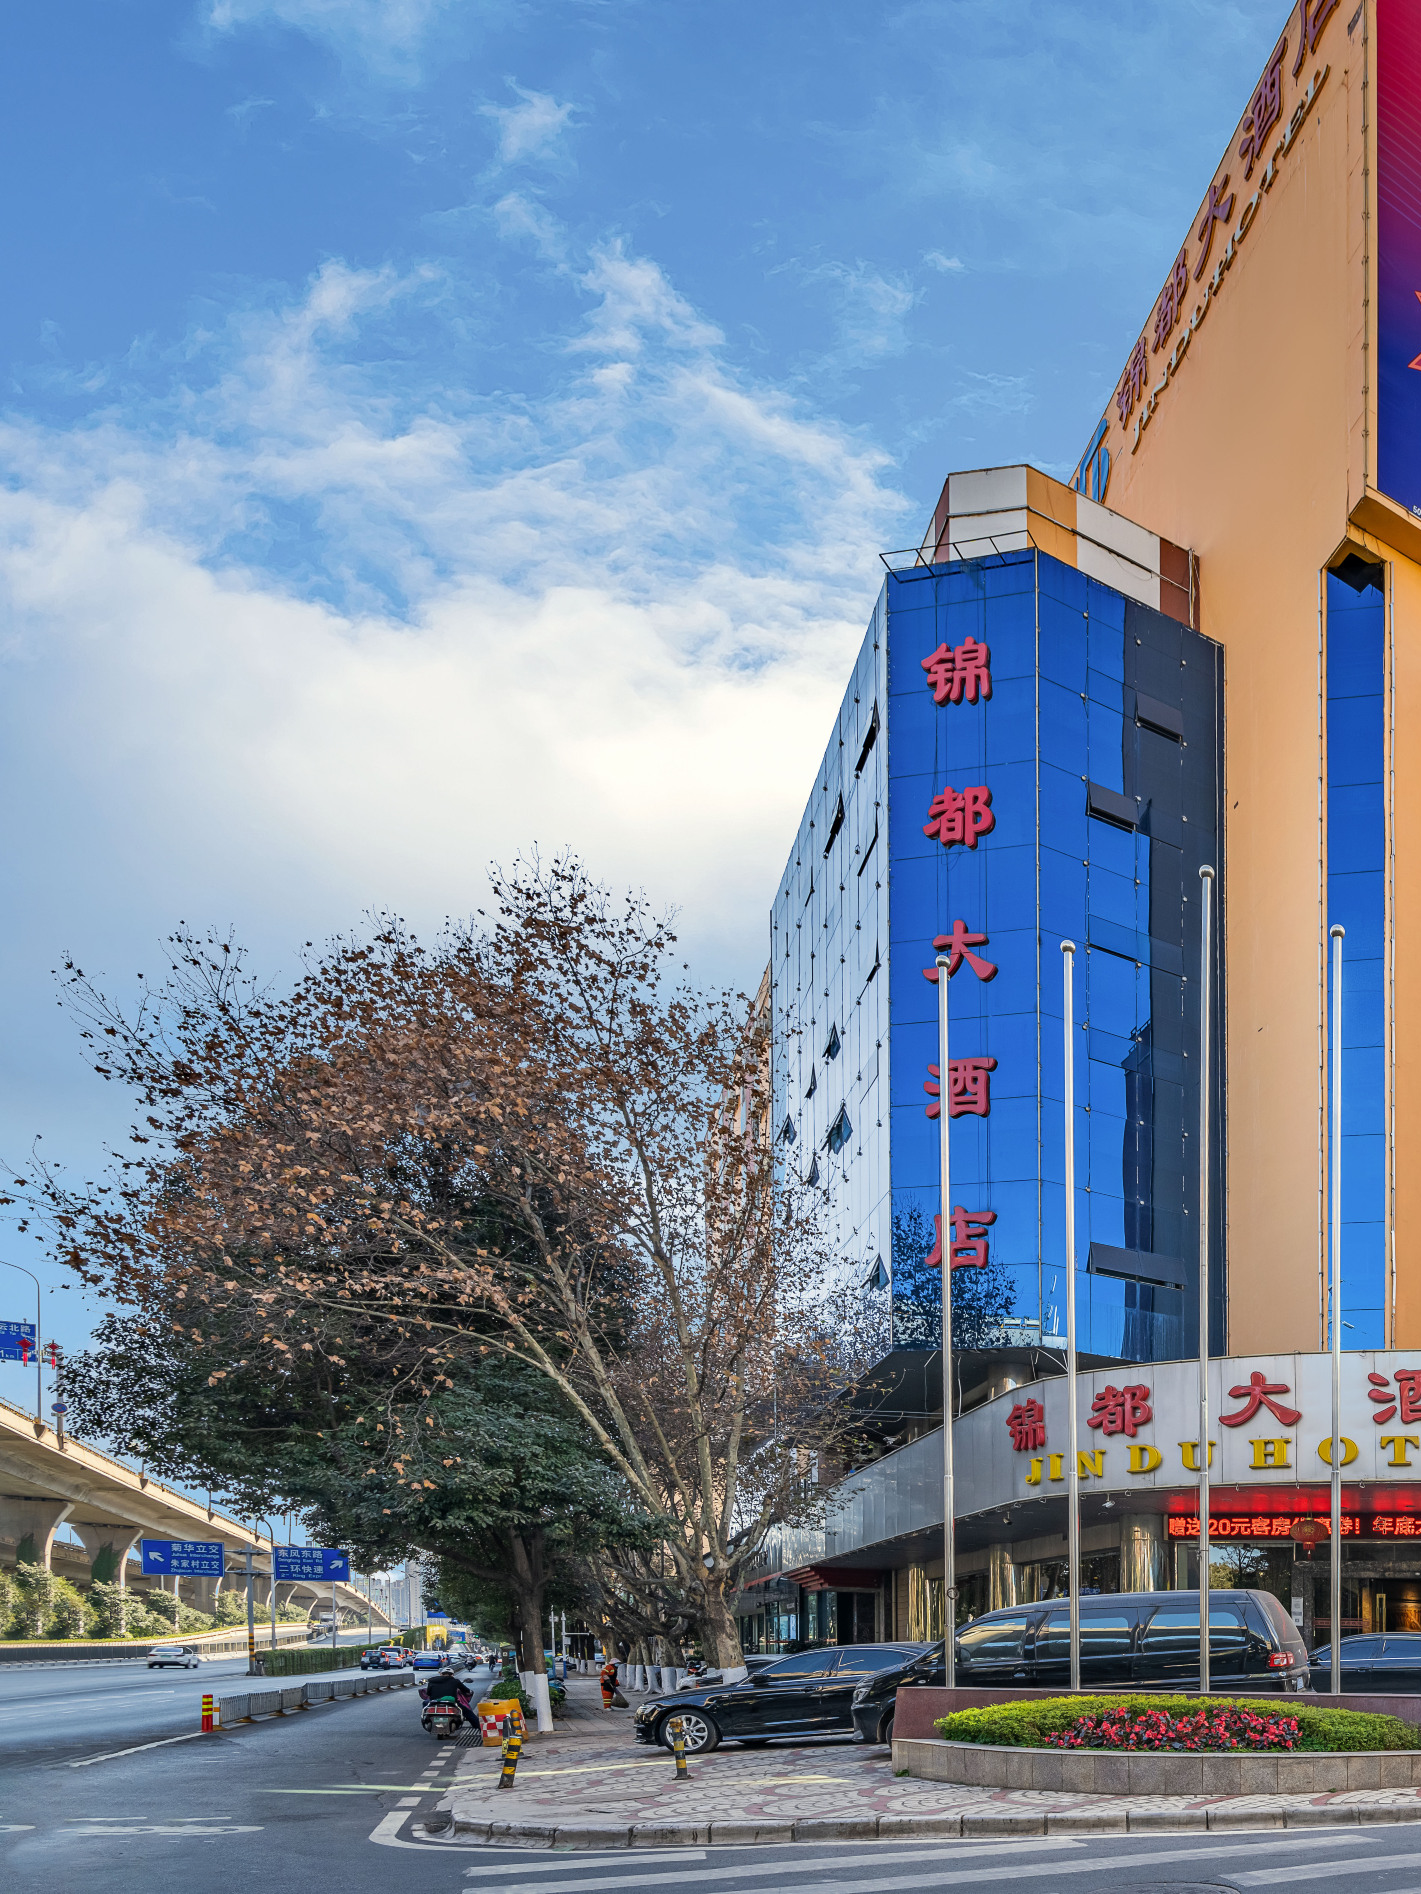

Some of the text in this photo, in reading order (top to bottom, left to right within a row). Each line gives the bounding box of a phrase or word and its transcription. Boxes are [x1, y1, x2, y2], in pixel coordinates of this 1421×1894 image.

[1213, 64, 1331, 297] HOTEL
[921, 636, 998, 1270] 锦都大酒店
[1025, 1440, 1216, 1486] JINDU
[171, 1543, 219, 1554] 菊华立交
[278, 1549, 323, 1559] 东风东路
[171, 1559, 219, 1569] 朱家村立交
[279, 1565, 324, 1574] 二环快速
